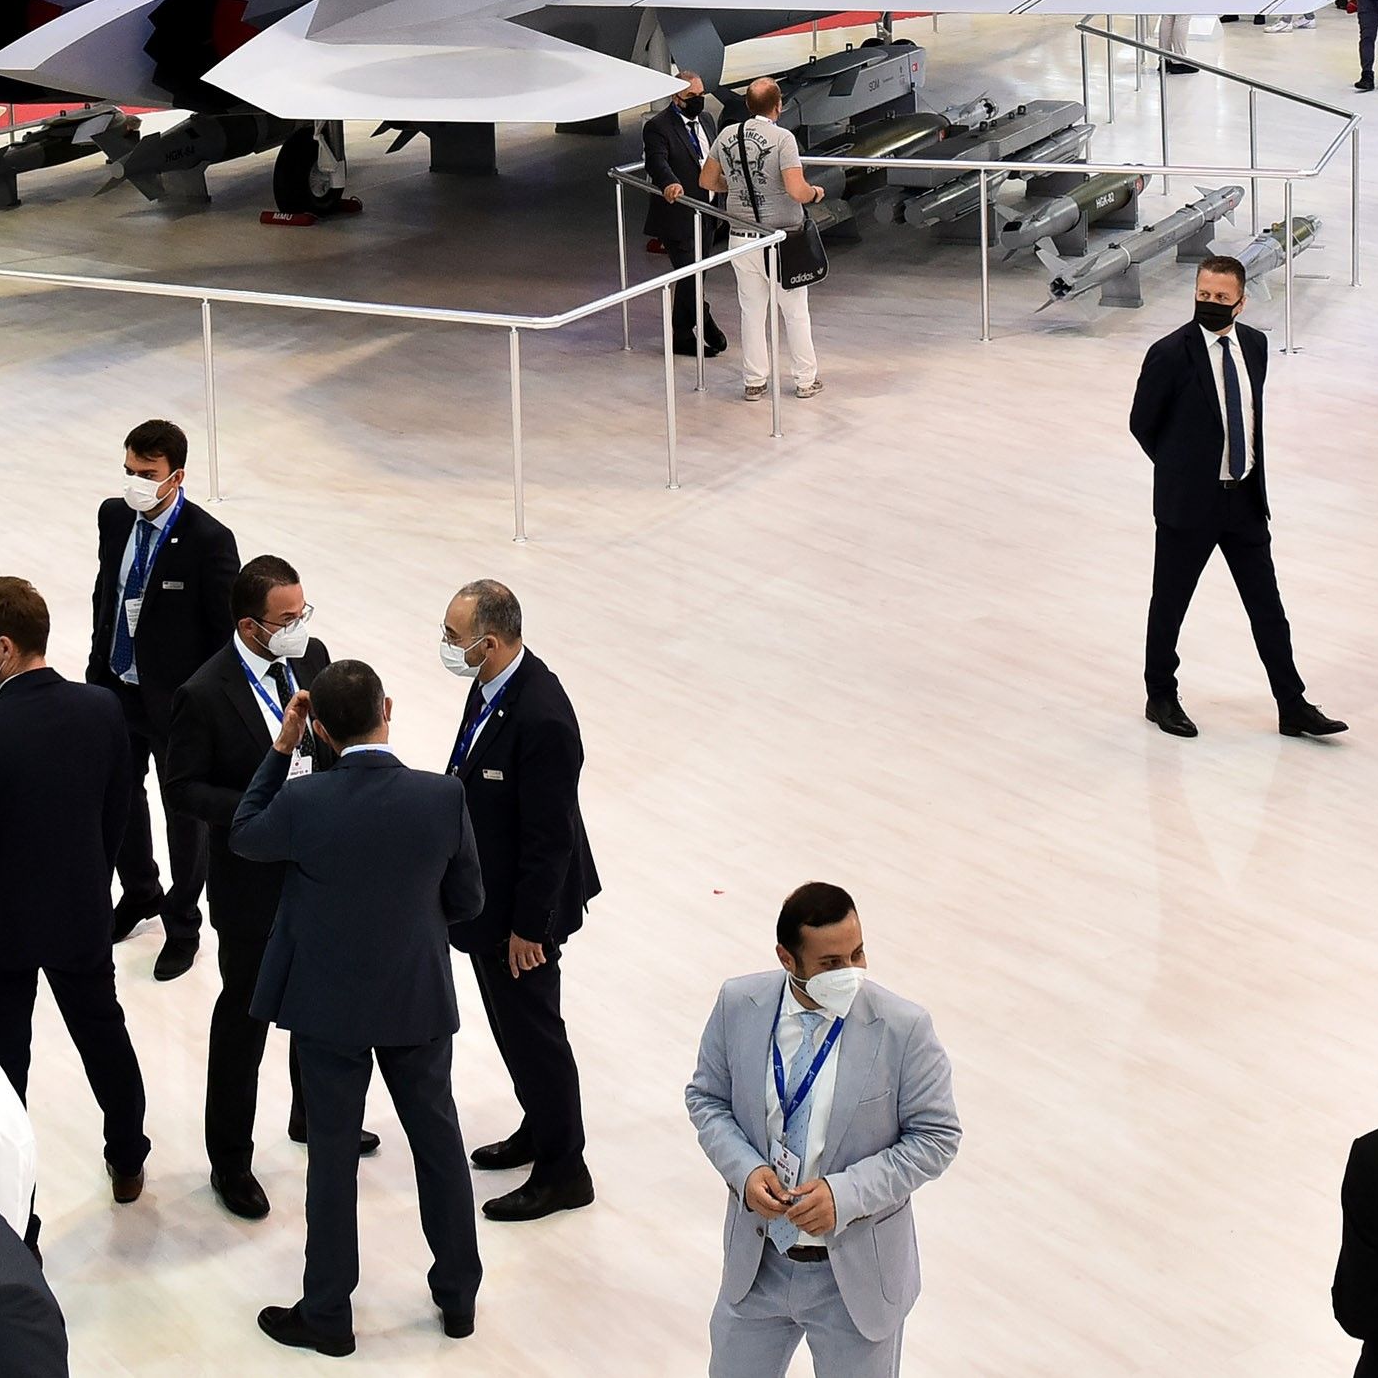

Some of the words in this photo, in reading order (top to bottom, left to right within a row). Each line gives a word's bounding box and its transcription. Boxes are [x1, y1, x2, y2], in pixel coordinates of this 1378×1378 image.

[728, 129, 768, 147] ENINEER
[1096, 192, 1115, 210] HGK-82
[273, 212, 293, 221] MMU
